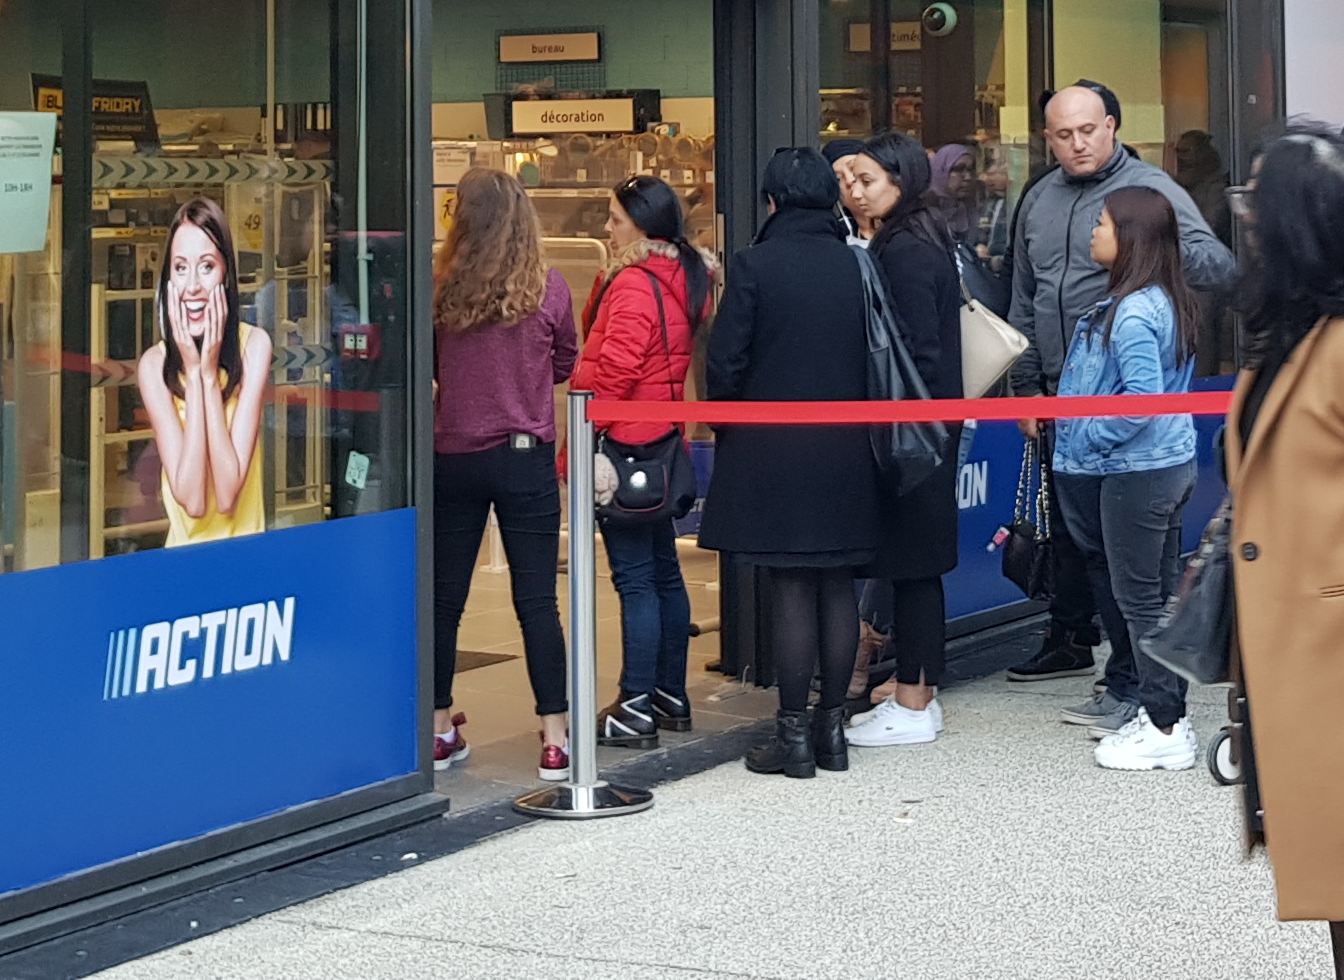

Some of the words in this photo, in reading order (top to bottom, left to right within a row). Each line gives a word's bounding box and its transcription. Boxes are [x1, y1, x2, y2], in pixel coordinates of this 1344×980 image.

[531, 43, 565, 54] bureau
[92, 97, 141, 112] FRIDAY
[541, 110, 605, 124] décoration
[135, 596, 296, 694] ACTION
